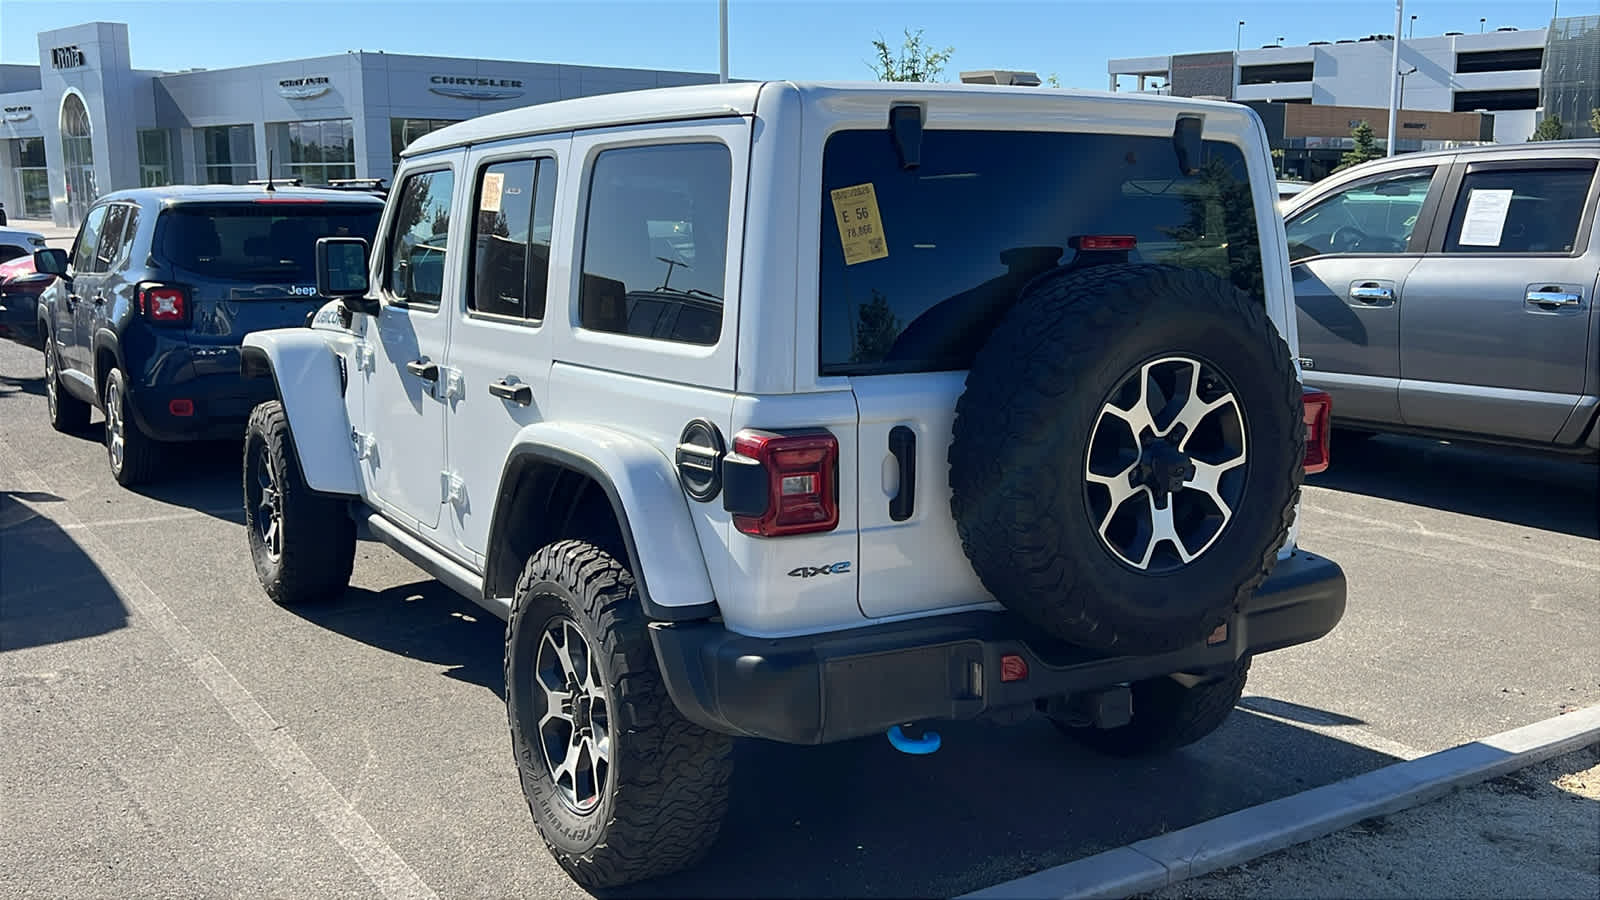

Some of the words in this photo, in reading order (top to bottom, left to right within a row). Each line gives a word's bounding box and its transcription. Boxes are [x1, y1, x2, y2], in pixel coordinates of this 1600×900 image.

[51, 46, 83, 69] Lithia
[430, 76, 523, 88] CHRYSLER
[842, 210, 850, 223] E
[855, 207, 869, 220] 56
[288, 285, 317, 296] Jeep
